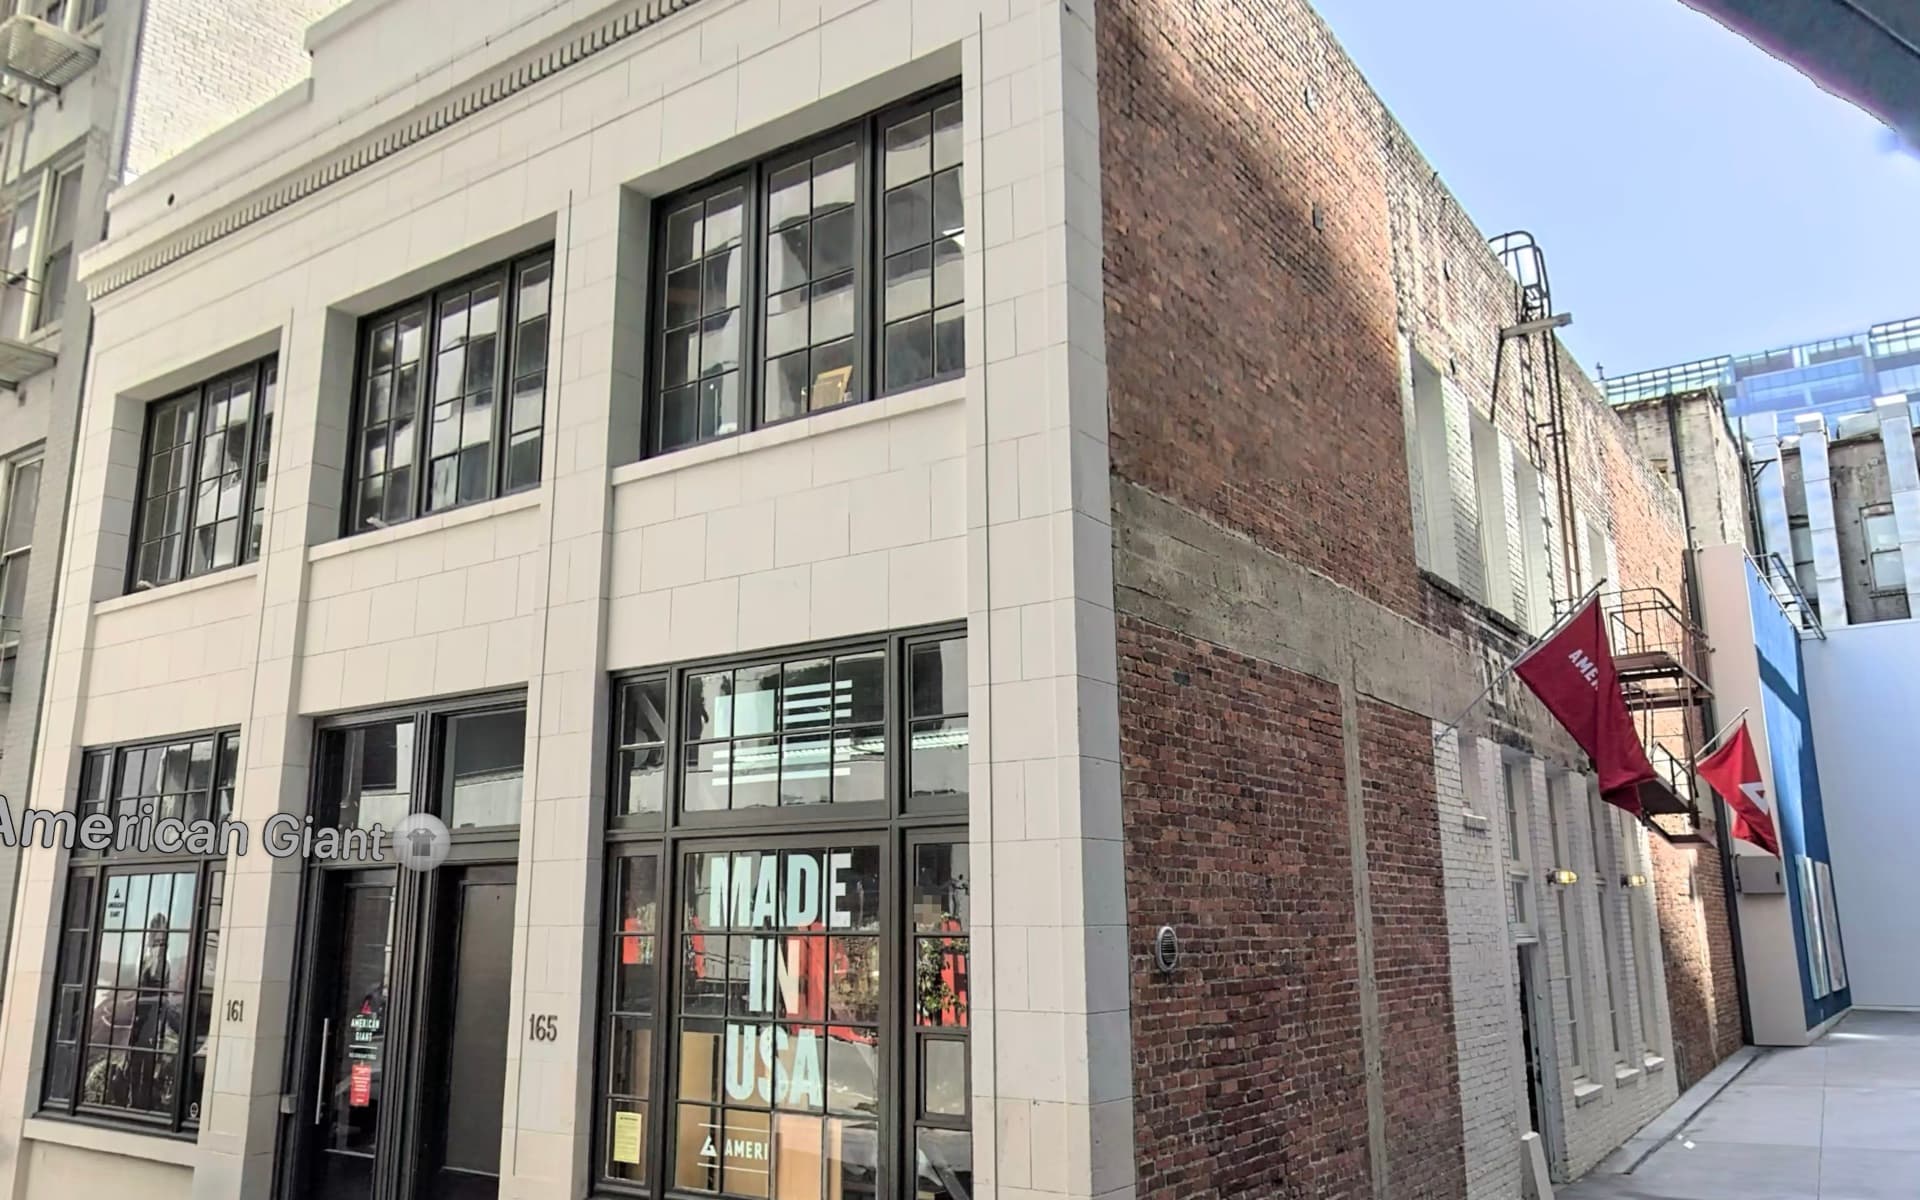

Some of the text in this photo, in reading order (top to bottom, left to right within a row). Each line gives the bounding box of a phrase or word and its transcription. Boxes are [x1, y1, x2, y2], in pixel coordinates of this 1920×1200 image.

[708, 852, 852, 929] MADE
[226, 999, 244, 1022] 161
[749, 938, 801, 1015] IN
[529, 1013, 558, 1042] 165
[725, 1023, 824, 1107] USA
